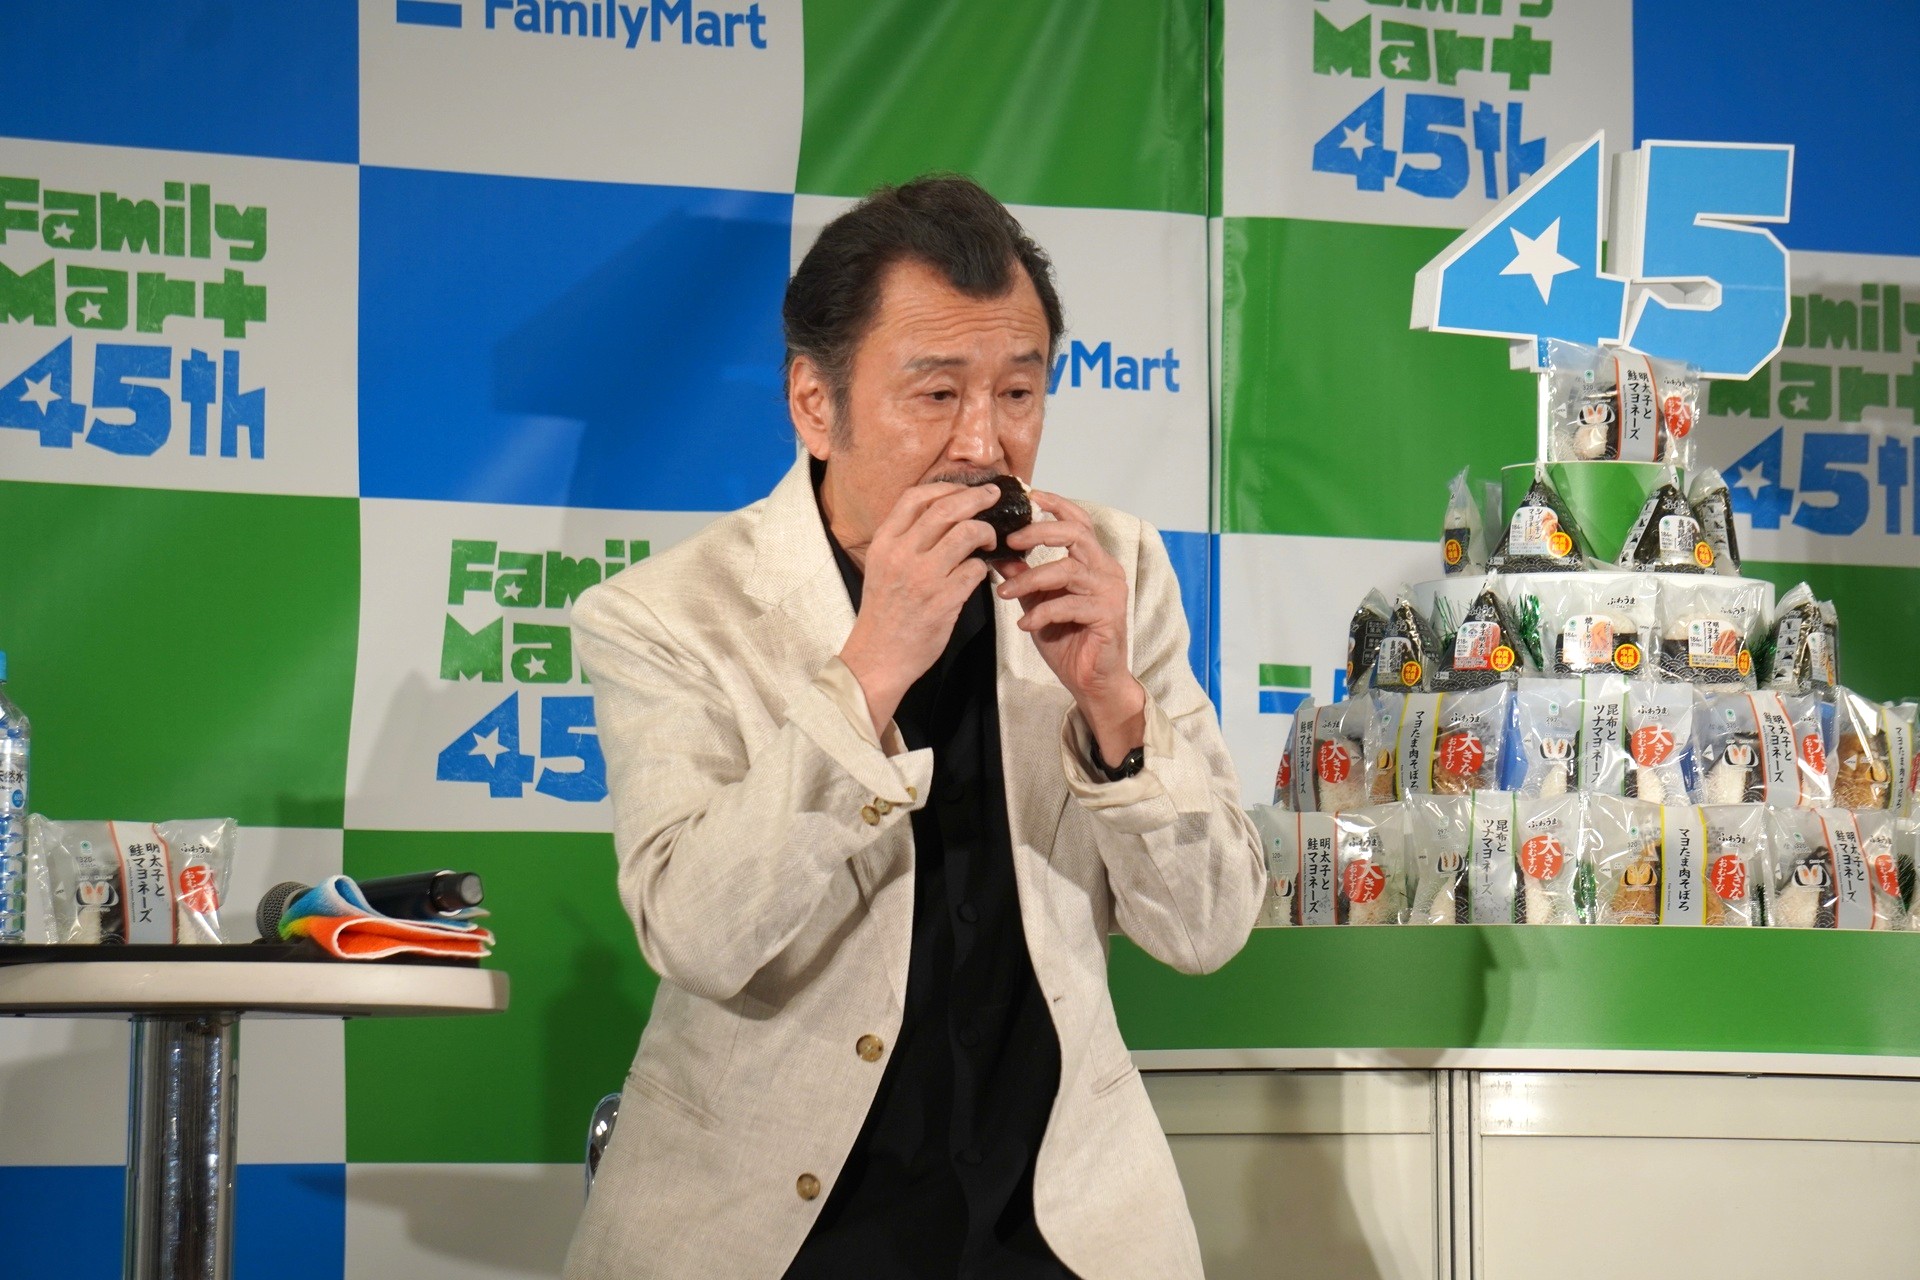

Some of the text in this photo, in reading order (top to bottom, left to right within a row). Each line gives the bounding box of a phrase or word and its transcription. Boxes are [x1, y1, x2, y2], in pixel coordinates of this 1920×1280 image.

[1313, 9, 1552, 91] Mart
[1313, 86, 1547, 200] 45th
[0, 177, 268, 262] Family
[1412, 130, 1795, 381] 45
[0, 258, 268, 339] Mart
[1047, 340, 1180, 395] yMart
[0, 335, 266, 460] 45th
[1627, 370, 1640, 440] 鮭マヨネーズ
[1638, 373, 1653, 420] 明太子と
[1721, 426, 1920, 536] 45t
[448, 539, 651, 609] Fami
[1608, 596, 1636, 605] ふわうま
[440, 613, 593, 684] Ma
[1478, 622, 1487, 656] 辛子明太子
[1712, 621, 1720, 641] 明太子
[1450, 713, 1481, 723] ふわうま
[1605, 704, 1619, 741] 昆布と
[1637, 705, 1668, 716] ふわうま
[437, 690, 609, 802] 45
[1305, 721, 1313, 772] 明太子と
[1320, 744, 1329, 780] おむすび
[1327, 737, 1347, 783] 大きな
[1408, 711, 1425, 789] マヨたま肉そぼろ
[1445, 737, 1457, 770] おむすび
[1456, 731, 1482, 776] 大きな
[1637, 731, 1648, 762] おむすび
[1647, 723, 1673, 767] 大きな
[1763, 712, 1785, 783] 鮭マヨネーズ
[1773, 715, 1792, 761] 明太子と
[1495, 819, 1509, 852] 昆布と
[1528, 818, 1558, 829] ふわうま
[1719, 833, 1746, 844] ふわうま
[146, 843, 165, 897] 明太子と
[1307, 838, 1319, 913] 鮭マヨネーズ
[1319, 837, 1331, 891] 明太子と
[1481, 819, 1494, 895] ツナマヨネーズ
[1528, 840, 1538, 874] おむすび
[1538, 833, 1561, 880] 大きな
[1678, 828, 1692, 912] マヨたま肉そぼろ
[1715, 858, 1728, 893] おむすび
[1726, 856, 1745, 900] 大きな
[1834, 830, 1857, 902] 鮭マヨネーズ
[1845, 831, 1865, 881] 明太子と
[129, 843, 152, 923] 鮭マヨネーズ
[1349, 864, 1358, 898] おむすび
[1359, 861, 1383, 902] 大きな
